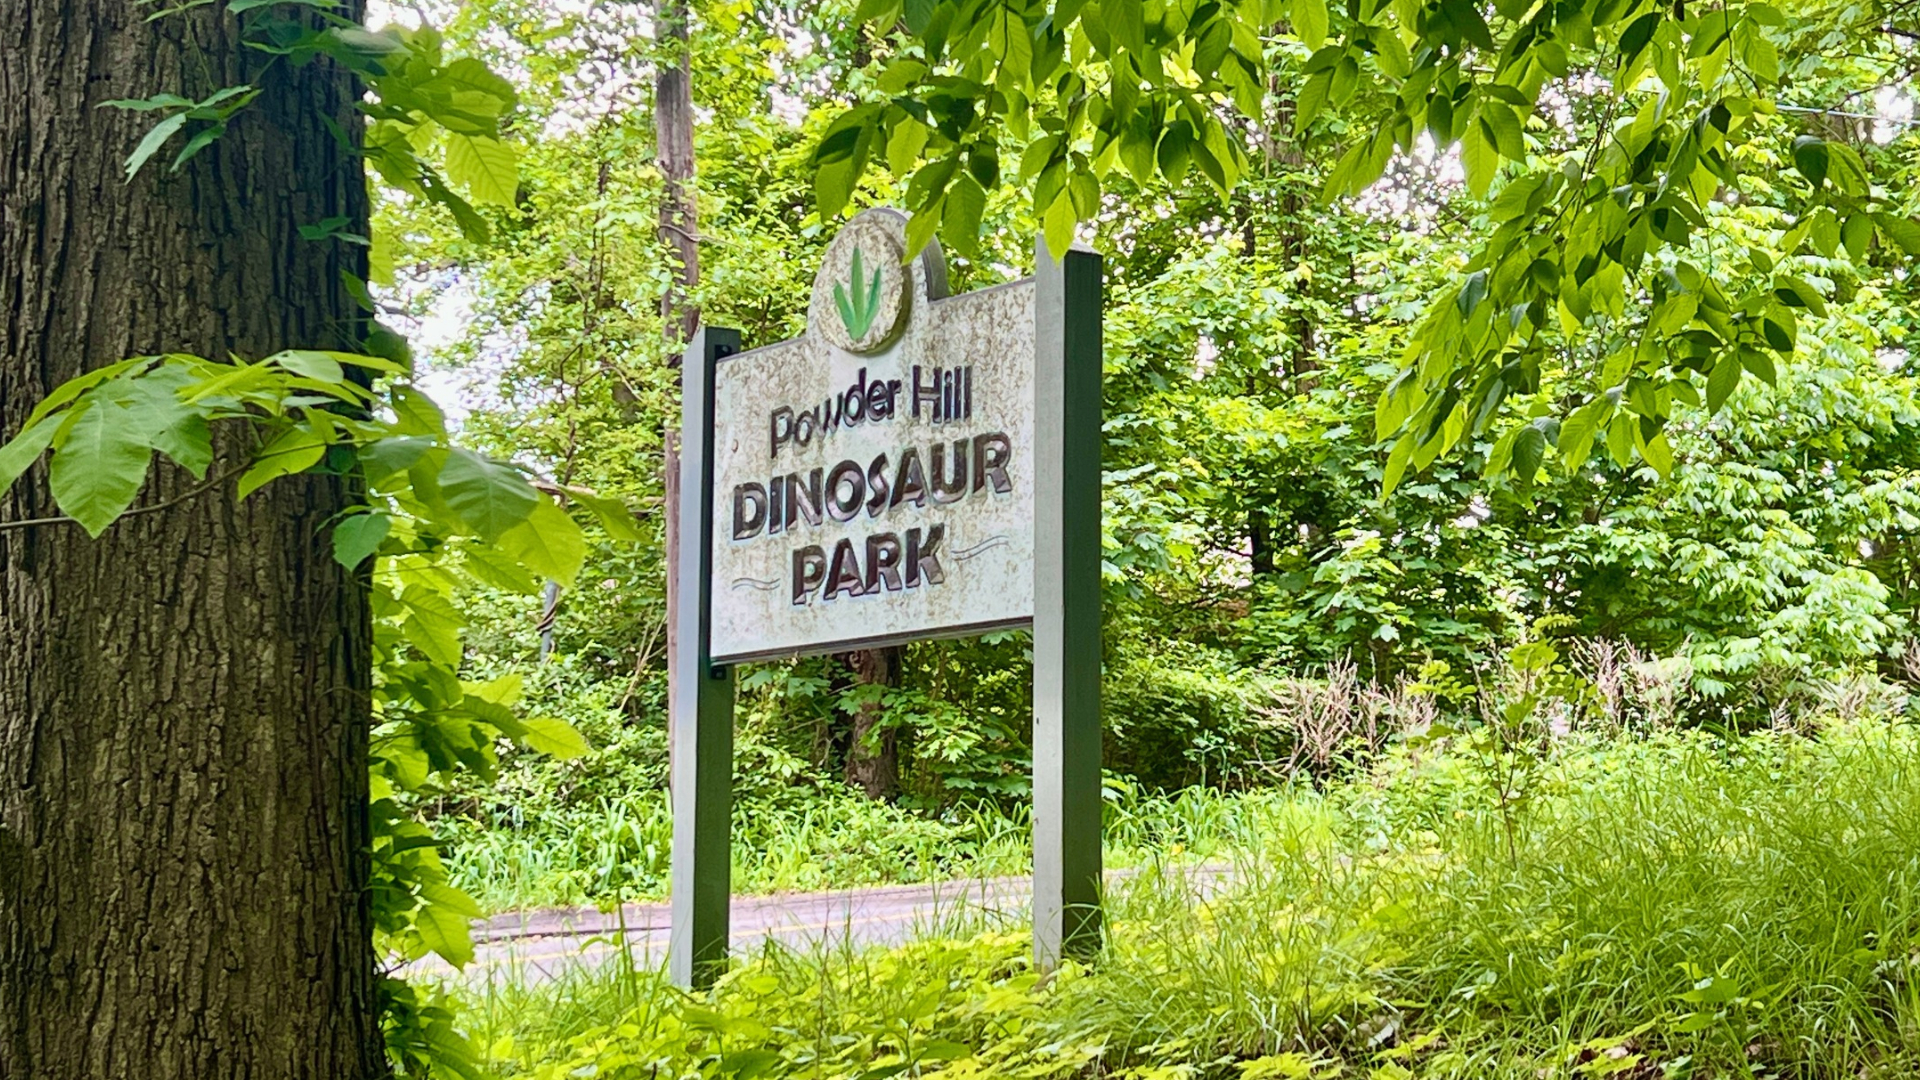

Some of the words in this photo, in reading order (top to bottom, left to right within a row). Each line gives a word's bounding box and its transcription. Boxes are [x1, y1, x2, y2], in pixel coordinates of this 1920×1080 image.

[770, 367, 901, 459] Powder
[912, 364, 973, 423] Hill
[732, 431, 1012, 541] DINOSAUR
[792, 522, 945, 605] PARK
